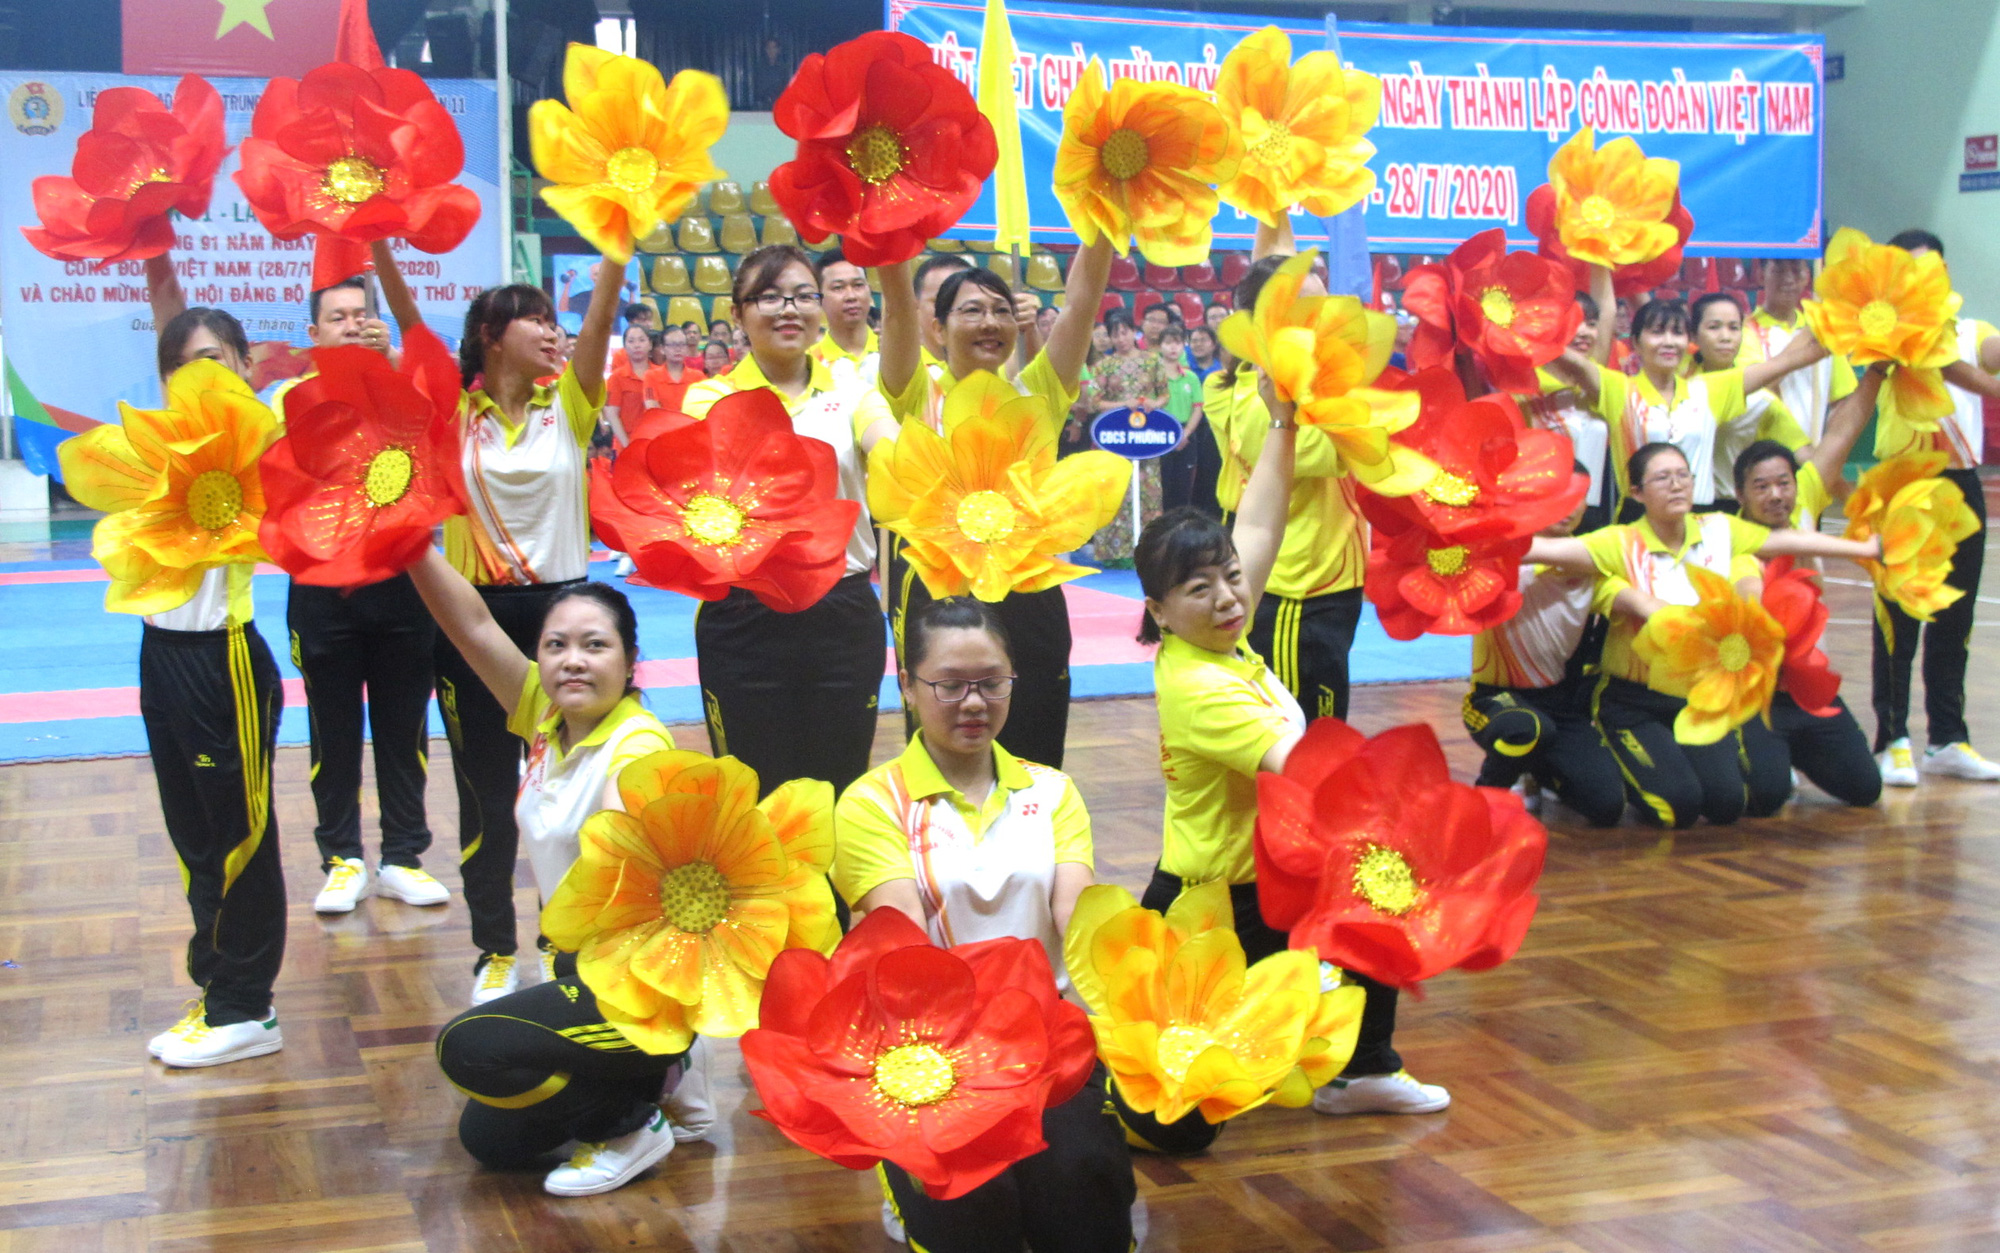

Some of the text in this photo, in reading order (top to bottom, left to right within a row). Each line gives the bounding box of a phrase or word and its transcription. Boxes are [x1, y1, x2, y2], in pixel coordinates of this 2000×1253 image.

[1381, 62, 1442, 127] NGÀY
[1446, 64, 1525, 130] THÀNH
[1529, 65, 1576, 141] LẬP
[1579, 67, 1642, 132] CÔNG
[1643, 68, 1707, 132] ĐOÀN
[1708, 69, 1760, 144] VIỆT
[1765, 83, 1812, 134] NAM
[1386, 164, 1517, 225] 28/7/2020)
[201, 235, 218, 251] 91
[227, 231, 265, 251] NĂM
[214, 261, 252, 277] NAM
[20, 283, 43, 302] VÀ
[50, 283, 96, 303] CHÀO
[103, 283, 150, 302] MỪNG
[195, 284, 223, 305] HỘI
[229, 282, 277, 303] ĐẢNG
[283, 283, 304, 305] BỘ
[425, 282, 456, 301] THỨ
